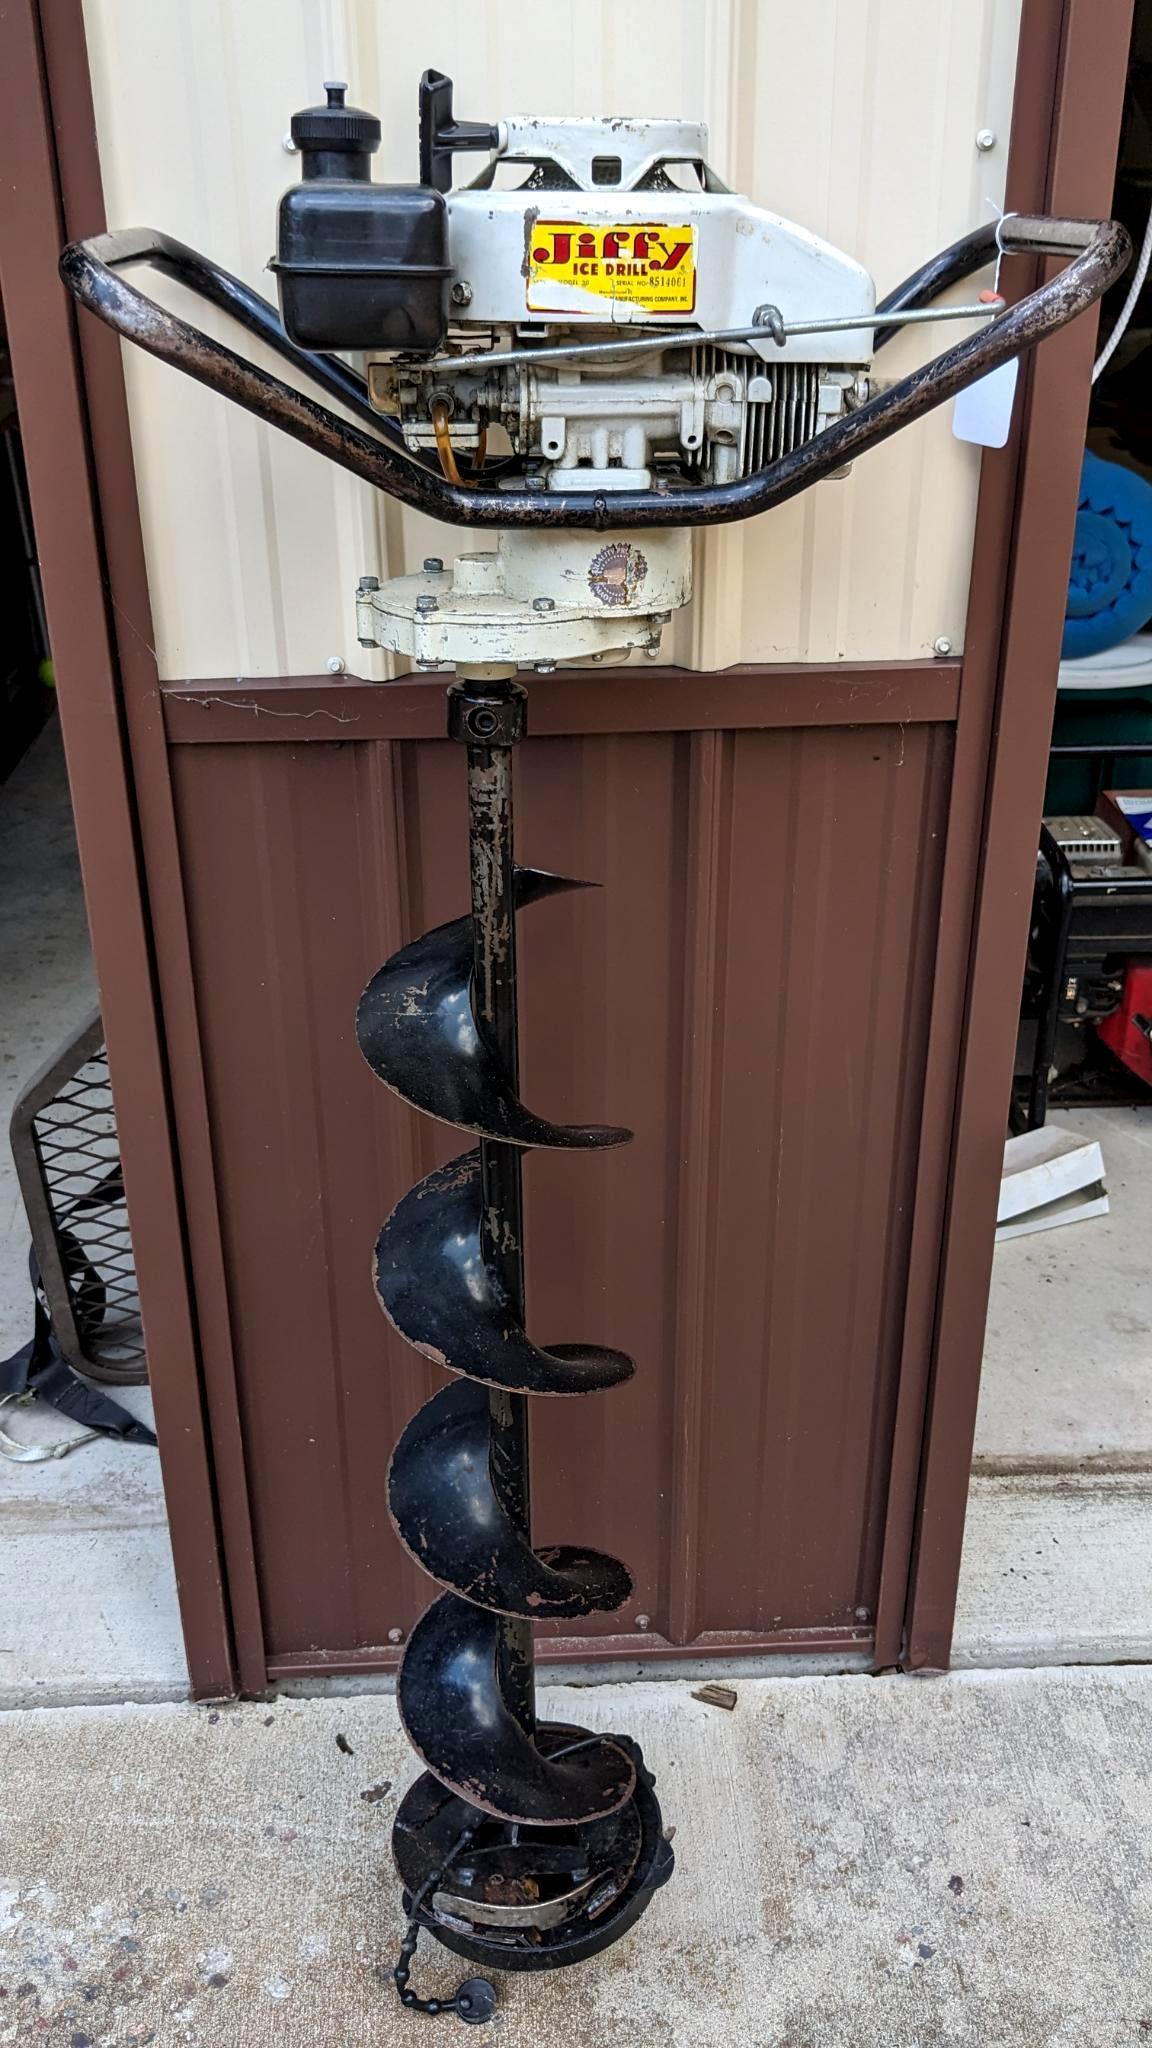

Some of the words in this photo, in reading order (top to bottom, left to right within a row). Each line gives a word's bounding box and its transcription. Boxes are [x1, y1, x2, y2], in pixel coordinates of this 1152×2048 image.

[533, 232, 693, 270] Jiffy
[573, 263, 598, 276] ICE
[606, 264, 648, 276] DRILL
